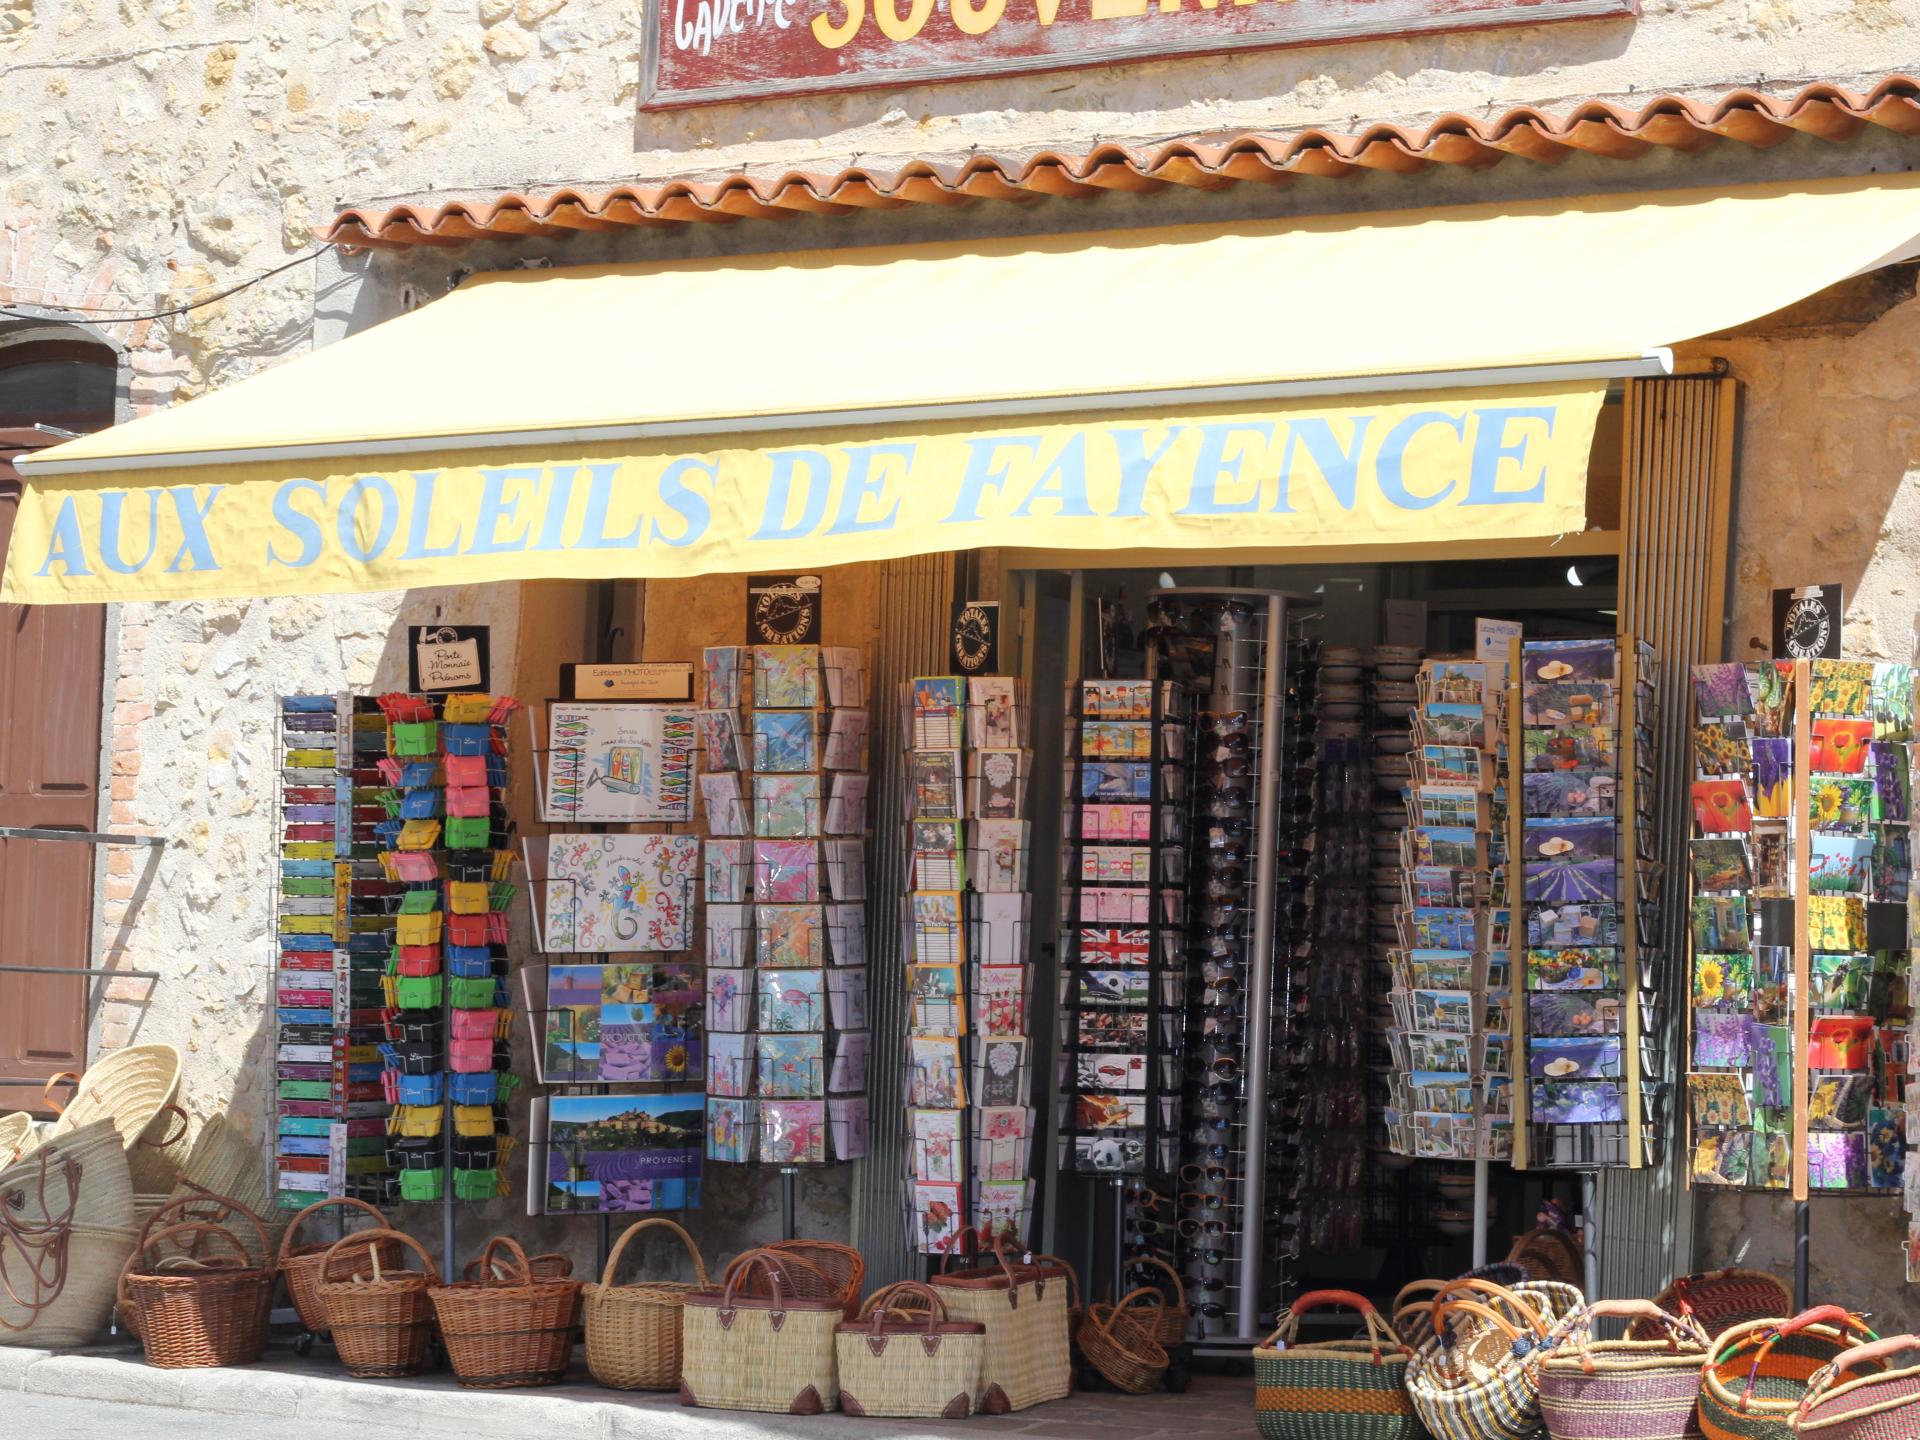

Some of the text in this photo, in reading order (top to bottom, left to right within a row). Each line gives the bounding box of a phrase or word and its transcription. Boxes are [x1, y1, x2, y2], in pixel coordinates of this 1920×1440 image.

[32, 404, 1559, 578] AUX SOLEILS DE FAYENCE
[1786, 600, 1822, 629] TOTALES
[1788, 620, 1828, 658] CREATIONS
[434, 648, 462, 660] Porte
[430, 660, 472, 670] Monnaie
[640, 1155, 693, 1165] PROVENCE
